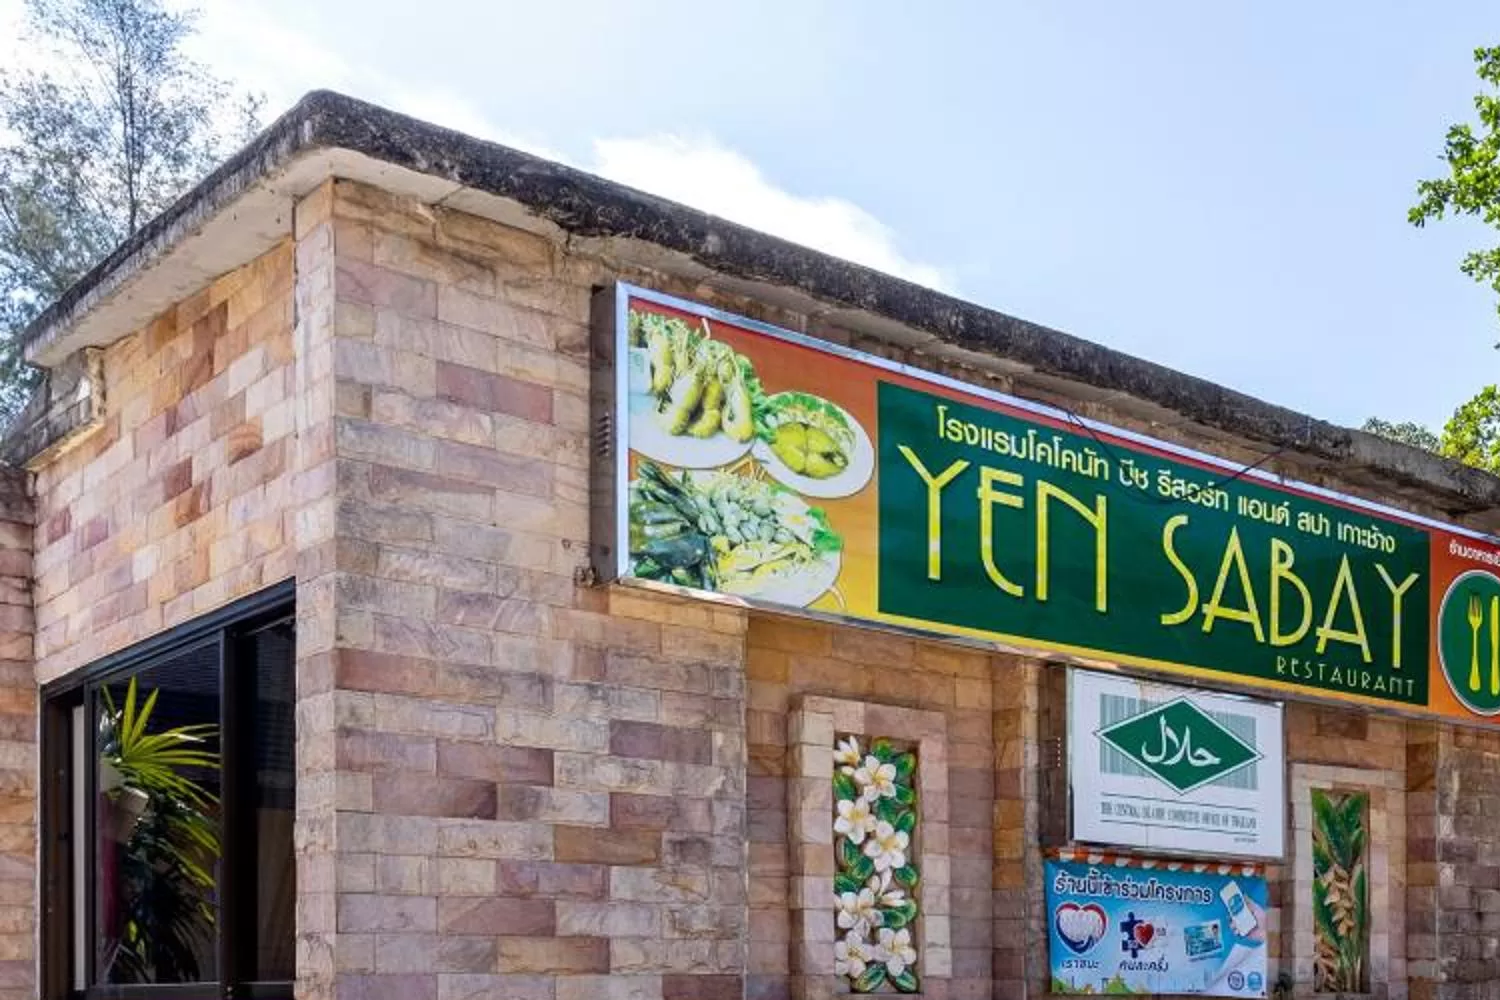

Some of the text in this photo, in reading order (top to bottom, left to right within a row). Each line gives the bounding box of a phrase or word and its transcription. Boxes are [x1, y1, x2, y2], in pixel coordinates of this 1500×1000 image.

[936, 405, 1109, 481] โรงแรมโคโคนัท
[1157, 469, 1229, 512] รีสอร์ท
[1238, 495, 1290, 527] แอนด์
[1297, 511, 1330, 537] สปา
[1338, 522, 1395, 553] เกาะช้าง
[898, 445, 1420, 668] YEN SABAY
[1276, 655, 1416, 697] RESTAURANT
[1141, 714, 1221, 767] حلال
